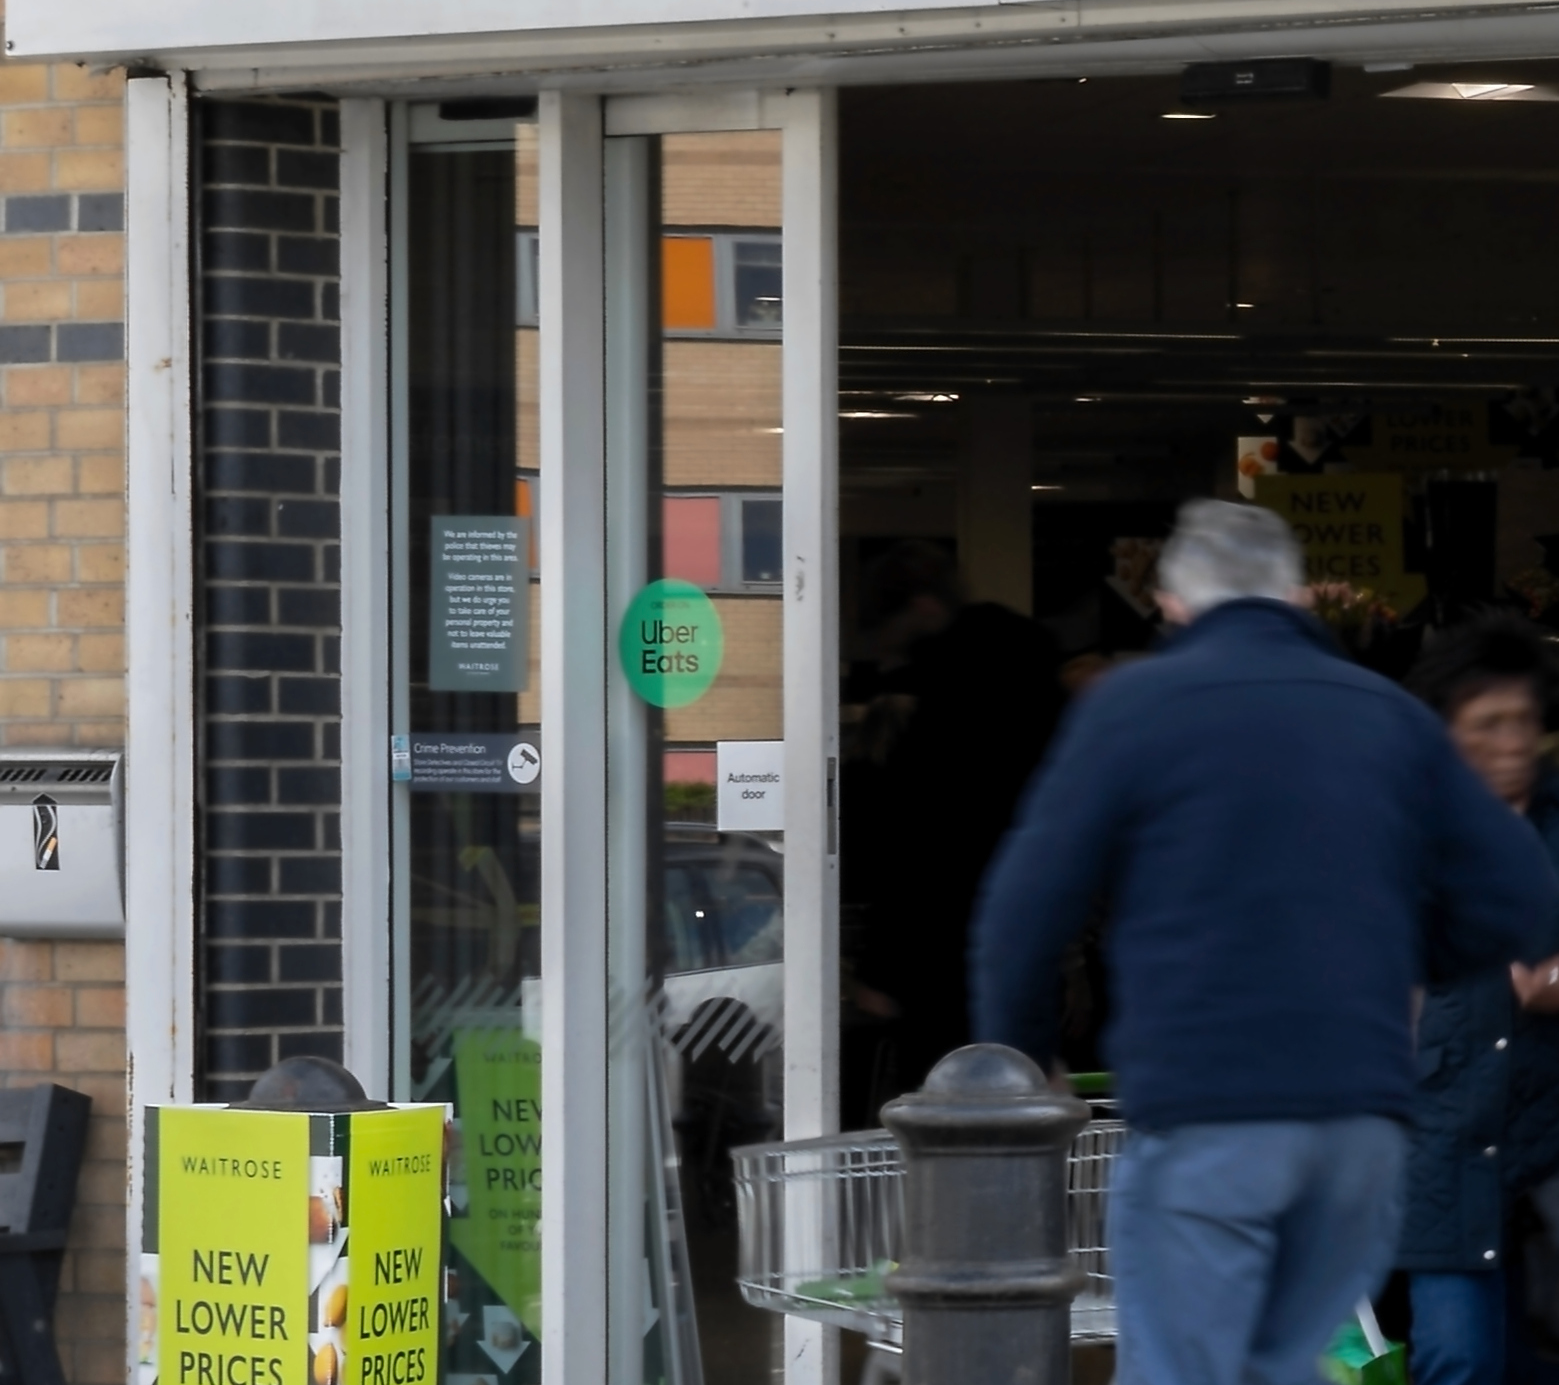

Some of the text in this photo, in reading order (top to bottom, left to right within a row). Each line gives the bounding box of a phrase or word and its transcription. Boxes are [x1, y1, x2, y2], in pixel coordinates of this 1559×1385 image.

[1290, 492, 1366, 512] NEW
[1292, 524, 1384, 544] OWER
[1302, 555, 1381, 577] RICES
[641, 620, 699, 644] Uber
[458, 663, 499, 671] WAITROSE
[642, 650, 699, 674] Eats
[414, 743, 486, 754] Crime Prevention
[727, 772, 780, 784] Automatic
[741, 789, 766, 800] door
[479, 1133, 542, 1156] LOW
[182, 1156, 282, 1180] WAITROSE
[369, 1154, 431, 1178] WAITROSE
[486, 1168, 542, 1191] PRIC
[192, 1249, 269, 1286] NEW
[375, 1247, 423, 1286] NEW
[176, 1299, 288, 1341] LOWER
[360, 1296, 429, 1340] LOWER
